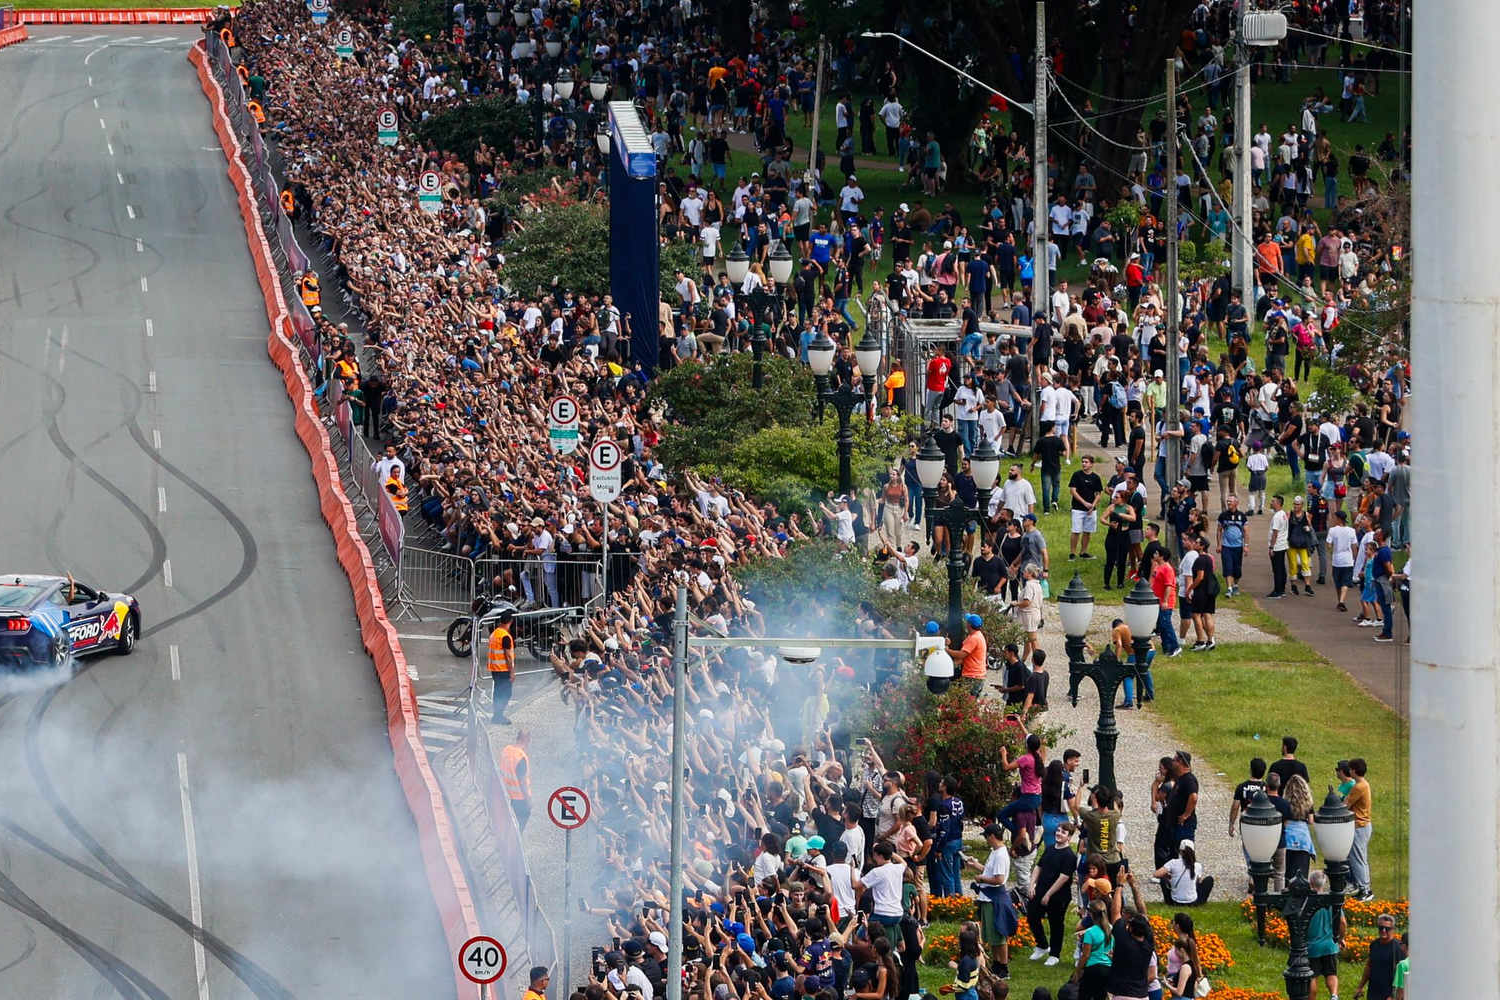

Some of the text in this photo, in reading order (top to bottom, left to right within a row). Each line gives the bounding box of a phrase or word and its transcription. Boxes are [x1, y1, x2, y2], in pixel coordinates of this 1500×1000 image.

[342, 32, 348, 41] E
[384, 113, 392, 124] E
[427, 175, 434, 187] E
[559, 402, 569, 418] E
[600, 446, 611, 464] E
[74, 623, 100, 641] FORD
[562, 796, 576, 820] E
[468, 947, 499, 967] 40
